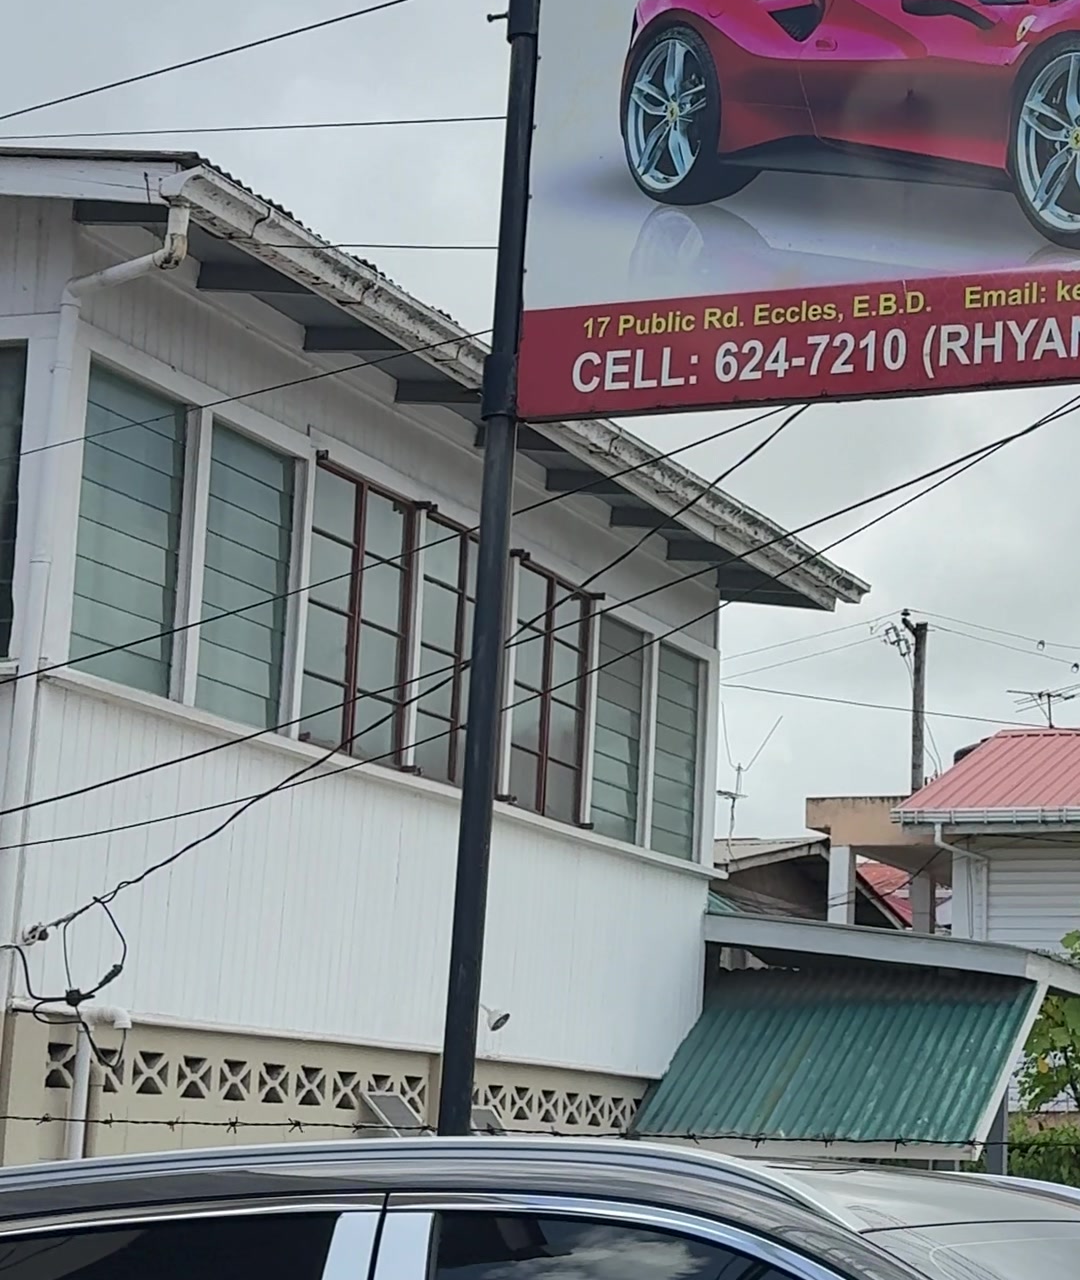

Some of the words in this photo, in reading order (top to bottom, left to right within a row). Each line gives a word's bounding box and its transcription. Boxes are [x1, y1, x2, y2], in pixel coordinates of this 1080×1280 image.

[583, 317, 611, 339] 17
[617, 311, 696, 337] Public
[703, 306, 744, 330] Rd.
[753, 300, 844, 326] Eccles,
[853, 291, 933, 318] E.B.D.
[964, 282, 1047, 309] Email:
[571, 347, 699, 393] CELL:
[714, 328, 907, 383] 624-7210
